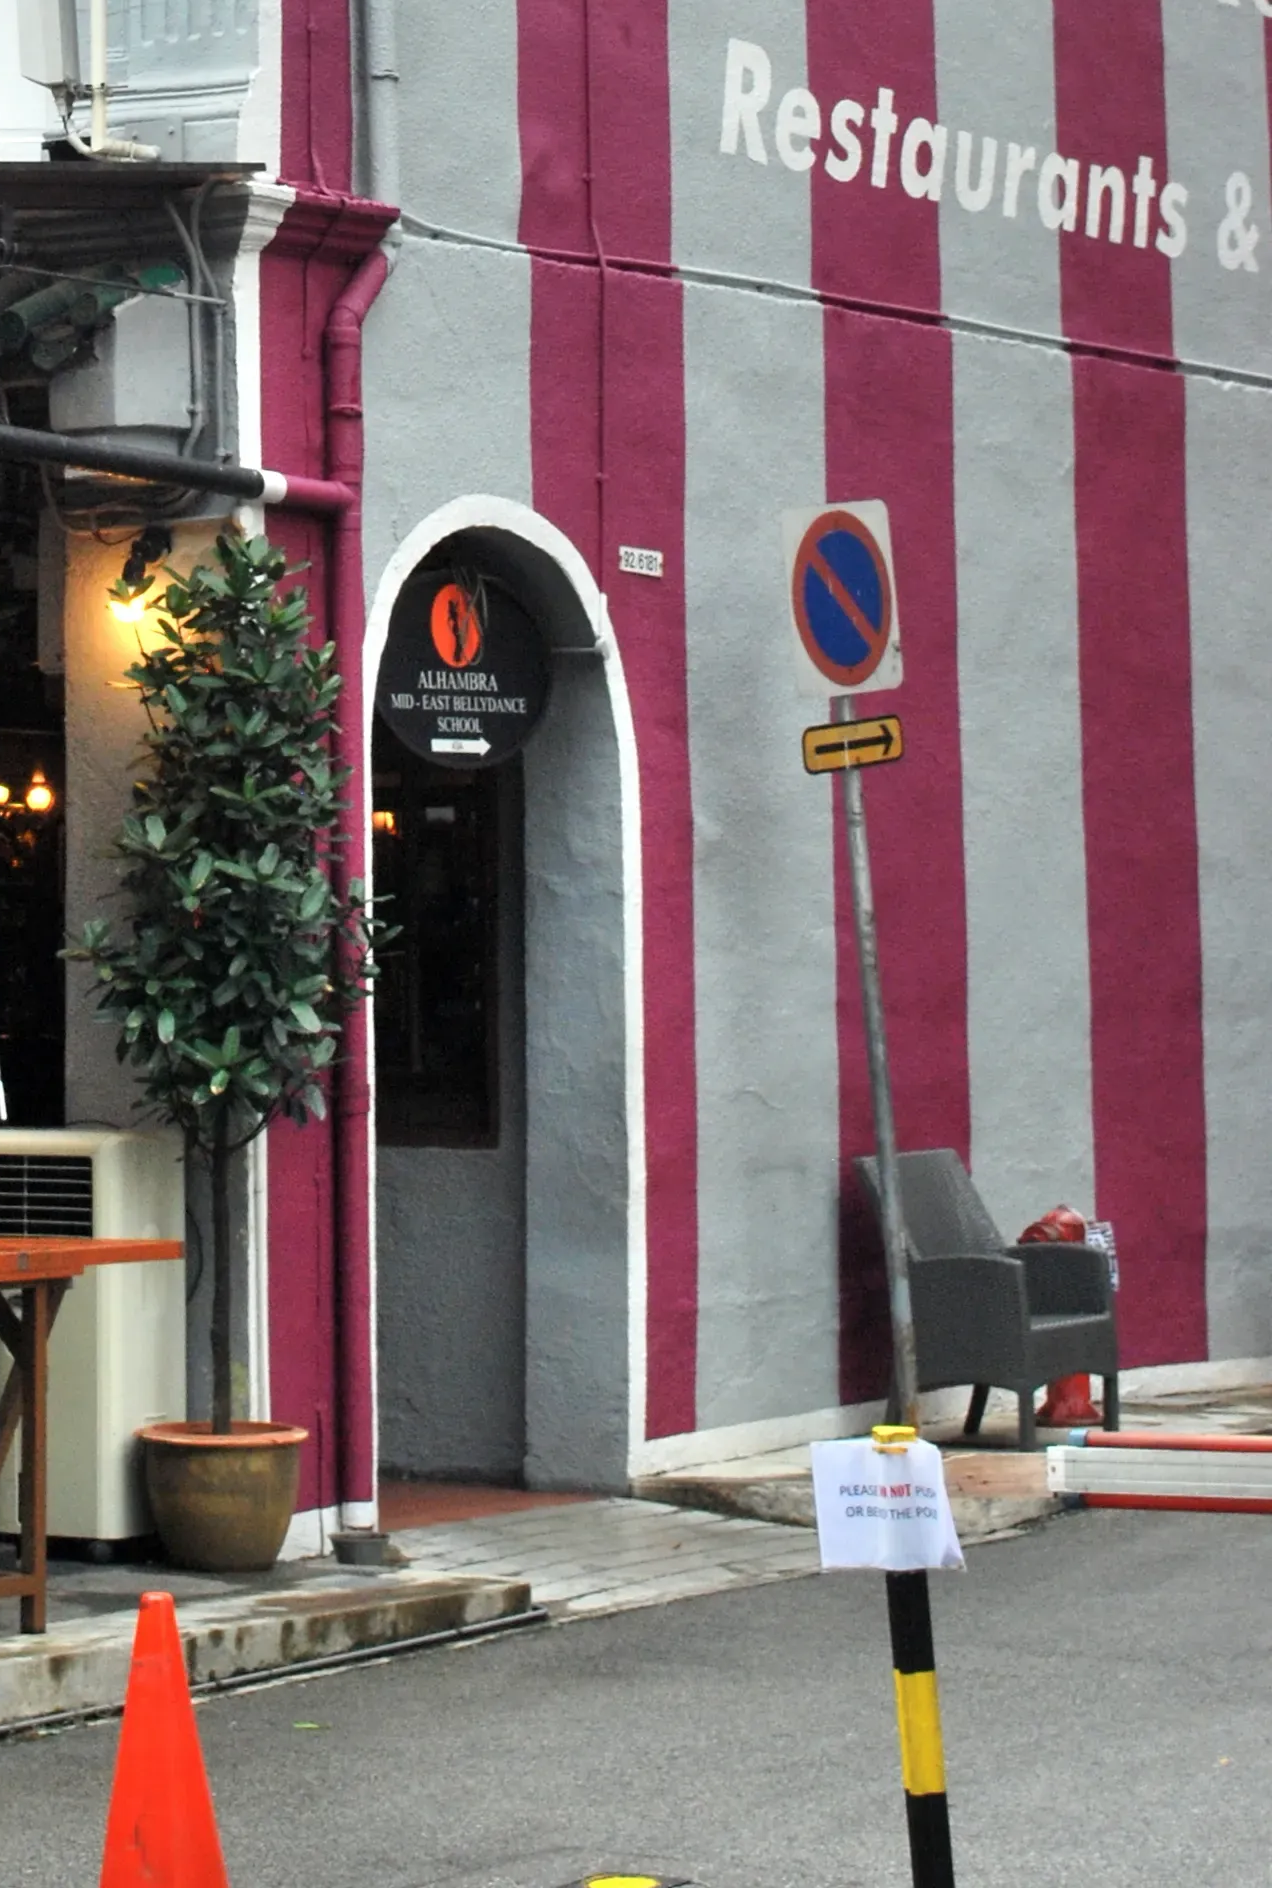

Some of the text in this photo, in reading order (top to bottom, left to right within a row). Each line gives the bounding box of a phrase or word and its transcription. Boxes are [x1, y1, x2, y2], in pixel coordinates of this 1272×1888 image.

[719, 36, 1260, 273] Restaurants &
[417, 670, 499, 692] ALHAMBRA
[453, 695, 527, 713] BELLYDANCE
[437, 716, 483, 733] SCHOOL
[890, 1483, 911, 1498] NOT
[845, 1506, 864, 1518] OR
[889, 1507, 913, 1520] THE
